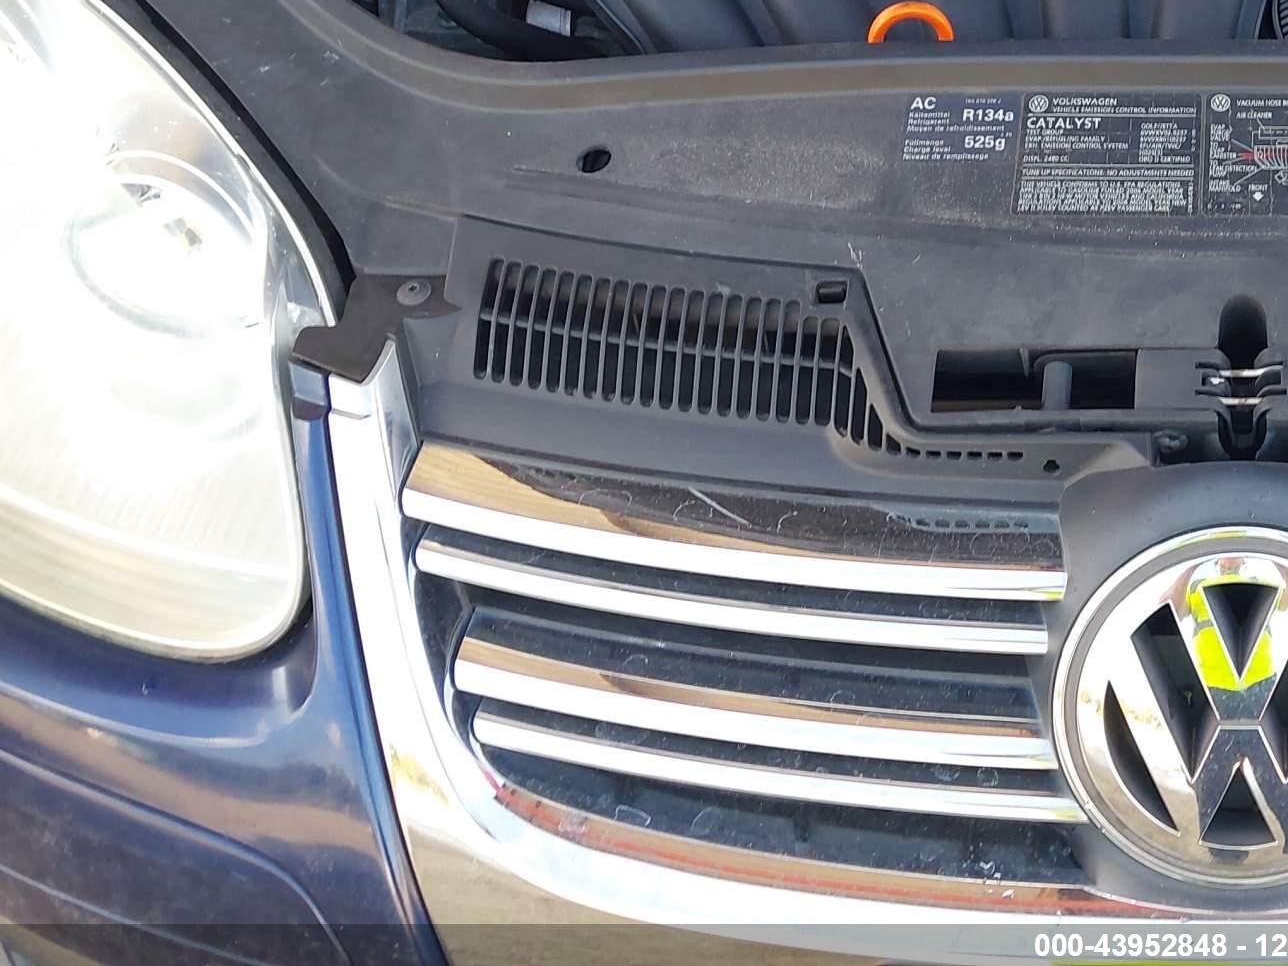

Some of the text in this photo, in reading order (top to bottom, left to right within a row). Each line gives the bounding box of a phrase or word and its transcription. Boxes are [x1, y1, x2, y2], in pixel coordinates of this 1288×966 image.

[910, 96, 937, 110] AC
[1052, 97, 1118, 106] VOLKSWAGEN
[1236, 99, 1265, 107] VACUUM
[1265, 99, 1282, 107] HOSE
[962, 108, 1015, 122] R134a
[1115, 106, 1147, 114] CONTROL
[1147, 106, 1197, 114] INFORMATION
[1026, 117, 1102, 129] CATALYST
[964, 135, 1006, 151] 525g
